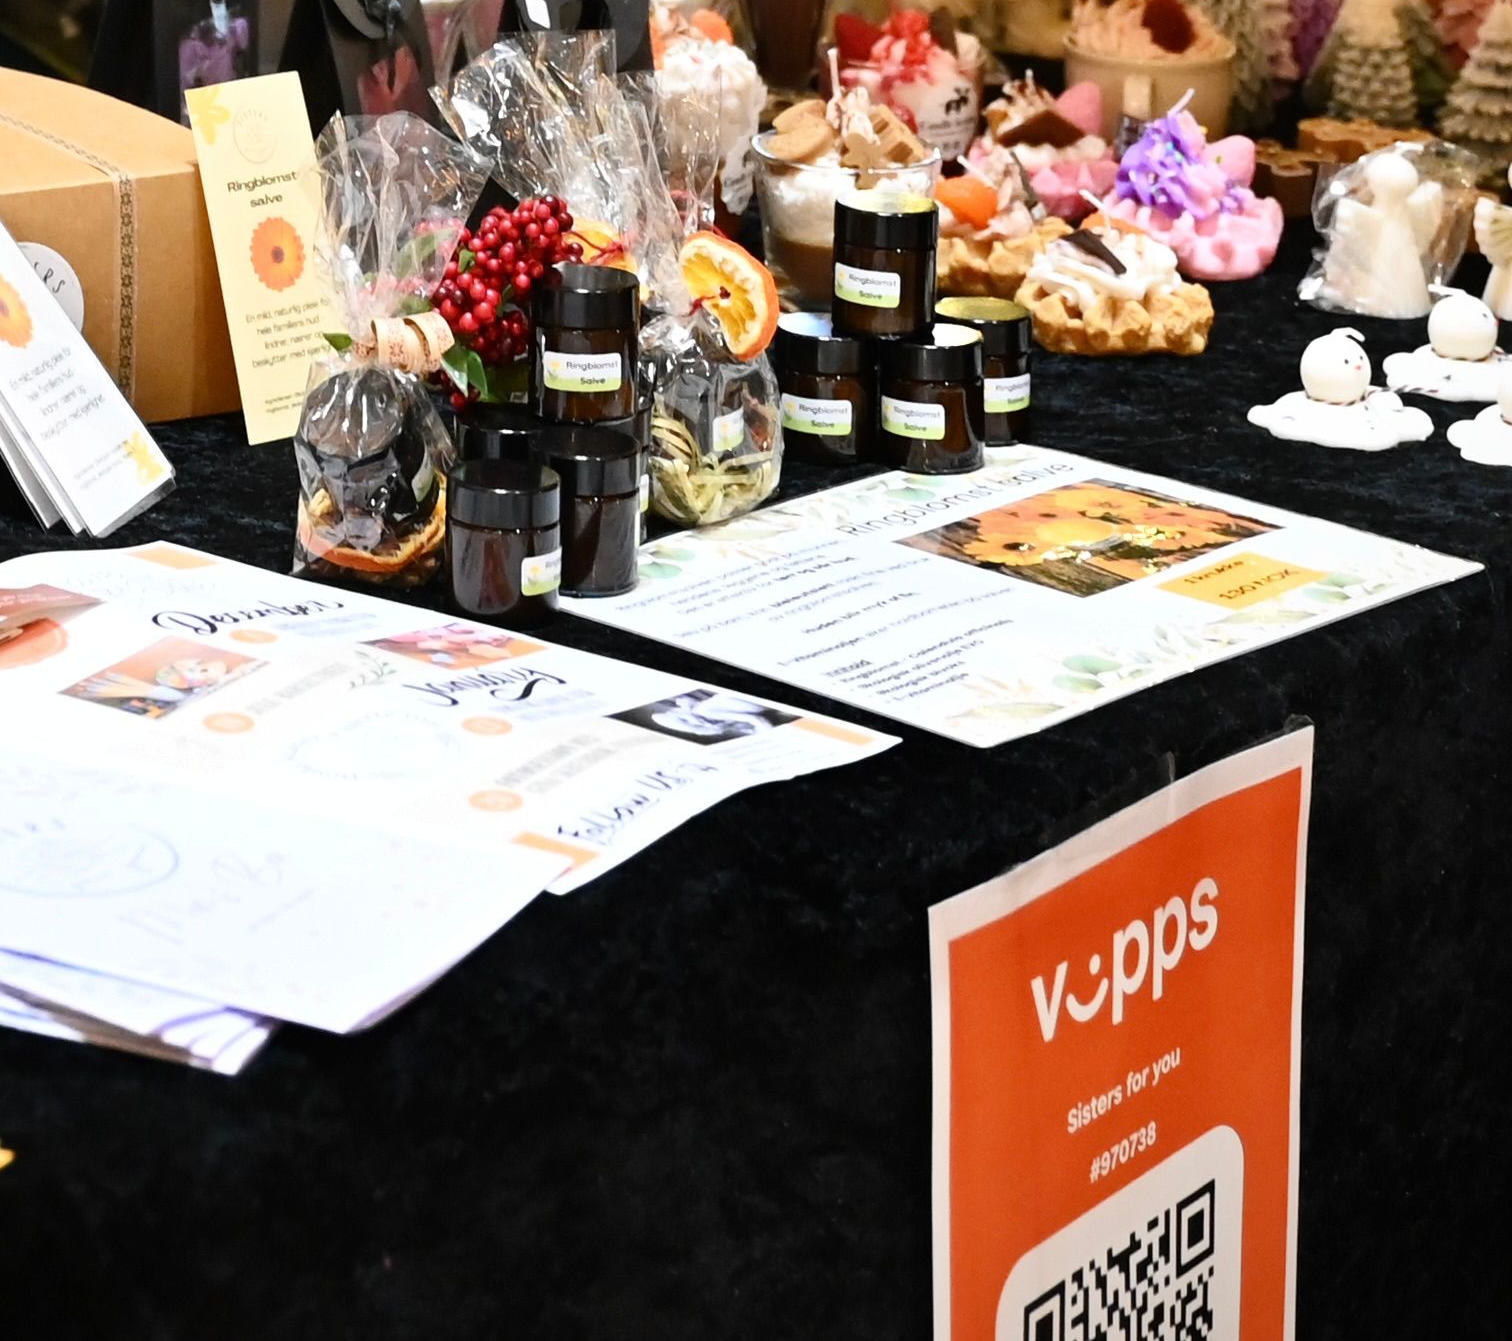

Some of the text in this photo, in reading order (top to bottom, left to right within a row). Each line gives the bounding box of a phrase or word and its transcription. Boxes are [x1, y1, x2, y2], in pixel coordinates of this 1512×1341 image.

[227, 171, 297, 192] Ringblomst
[250, 194, 283, 207] salve
[849, 274, 896, 287] Ringblomst
[859, 290, 882, 300] Salve
[566, 361, 618, 372] Ringblomst
[580, 377, 606, 385] Salve
[799, 404, 848, 415] Ringblomst
[894, 406, 941, 418] Ringblomst
[810, 420, 835, 428] Salve
[904, 423, 927, 431] Salve
[836, 463, 1075, 537] Ringblomst salve
[1253, 568, 1301, 586] NOK
[1067, 1047, 1181, 1133] Sisters for you
[1090, 1121, 1157, 1184] #970738
